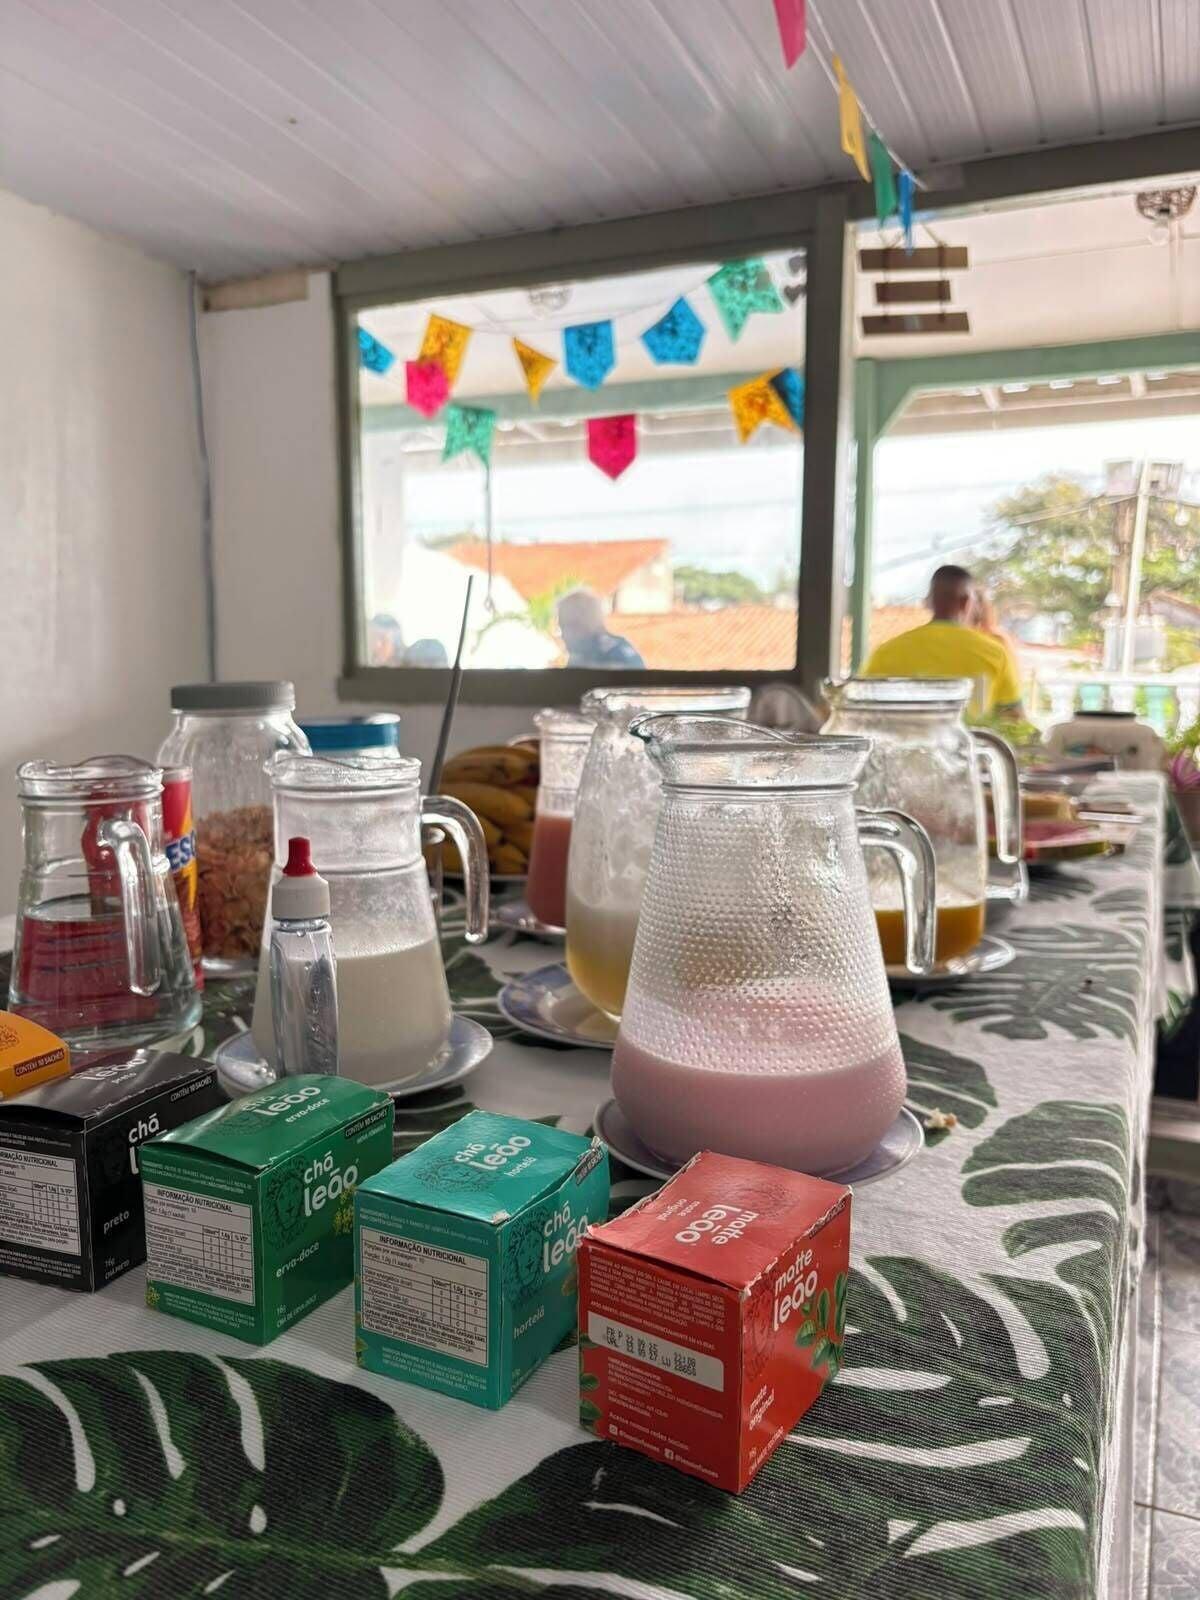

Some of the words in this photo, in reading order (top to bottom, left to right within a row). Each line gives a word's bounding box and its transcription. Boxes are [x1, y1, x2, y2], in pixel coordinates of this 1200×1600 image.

[252, 1086, 321, 1117] leão
[128, 1112, 160, 1143] chá
[304, 1150, 334, 1184] chá
[454, 1142, 487, 1164] chá
[468, 1135, 532, 1171] leão
[156, 1188, 193, 1204] INFORMAÇÃO
[194, 1197, 232, 1212] NUTRICIONAL
[304, 1164, 359, 1217] leão
[103, 1210, 130, 1235] preto
[544, 1200, 571, 1237] chá
[675, 1204, 742, 1244] leão
[711, 1210, 760, 1245] matte
[276, 1241, 320, 1278] erva-doce
[379, 1233, 421, 1254] INFORMAÇÃO
[422, 1247, 465, 1265] NUTRICIONAL
[774, 1249, 813, 1297] matte
[773, 1270, 818, 1332] leão
[513, 1305, 545, 1339] hortelã
